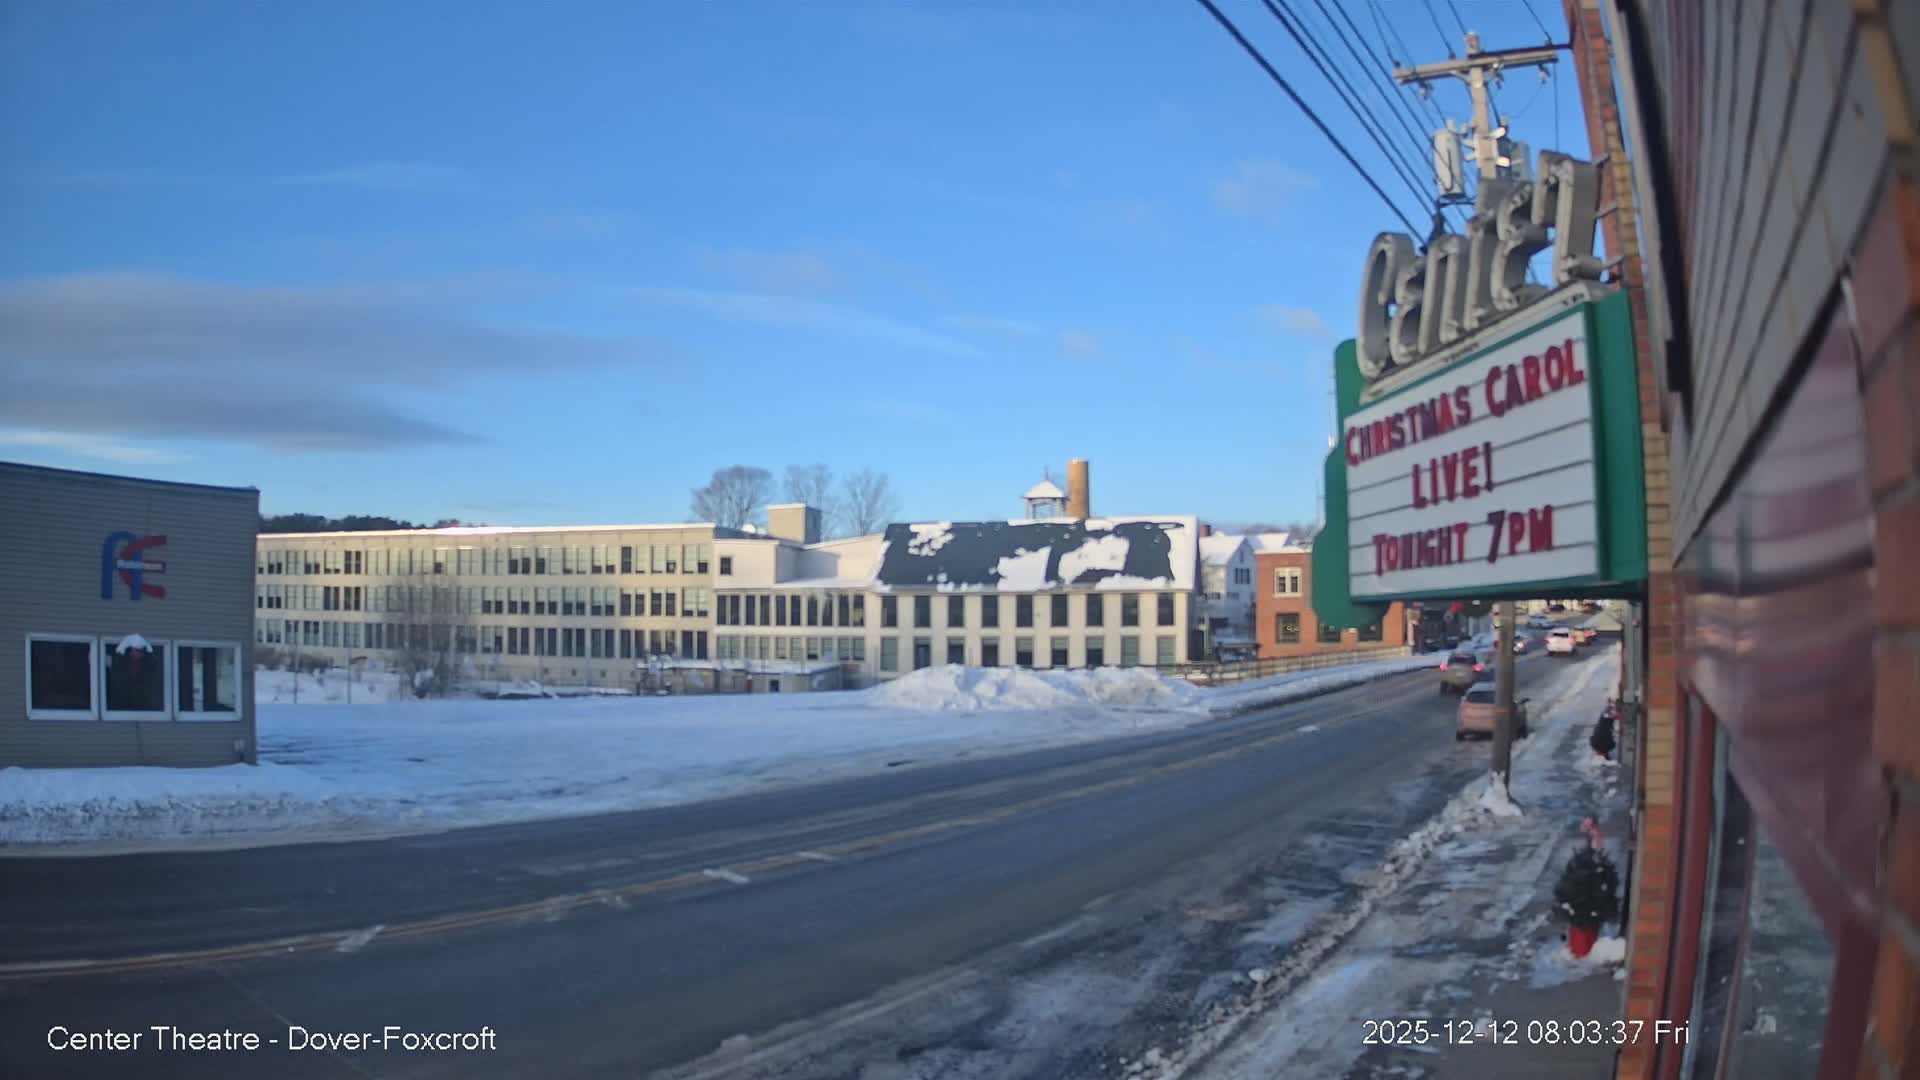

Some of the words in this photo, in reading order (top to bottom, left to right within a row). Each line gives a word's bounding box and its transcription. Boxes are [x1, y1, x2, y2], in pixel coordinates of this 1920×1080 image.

[1346, 386, 1471, 466] CHRISTMAS
[1485, 338, 1584, 418] CAROL
[1412, 441, 1494, 510] LIVE!
[1373, 522, 1470, 576] TONIGHT
[1486, 504, 1554, 564] 7PM
